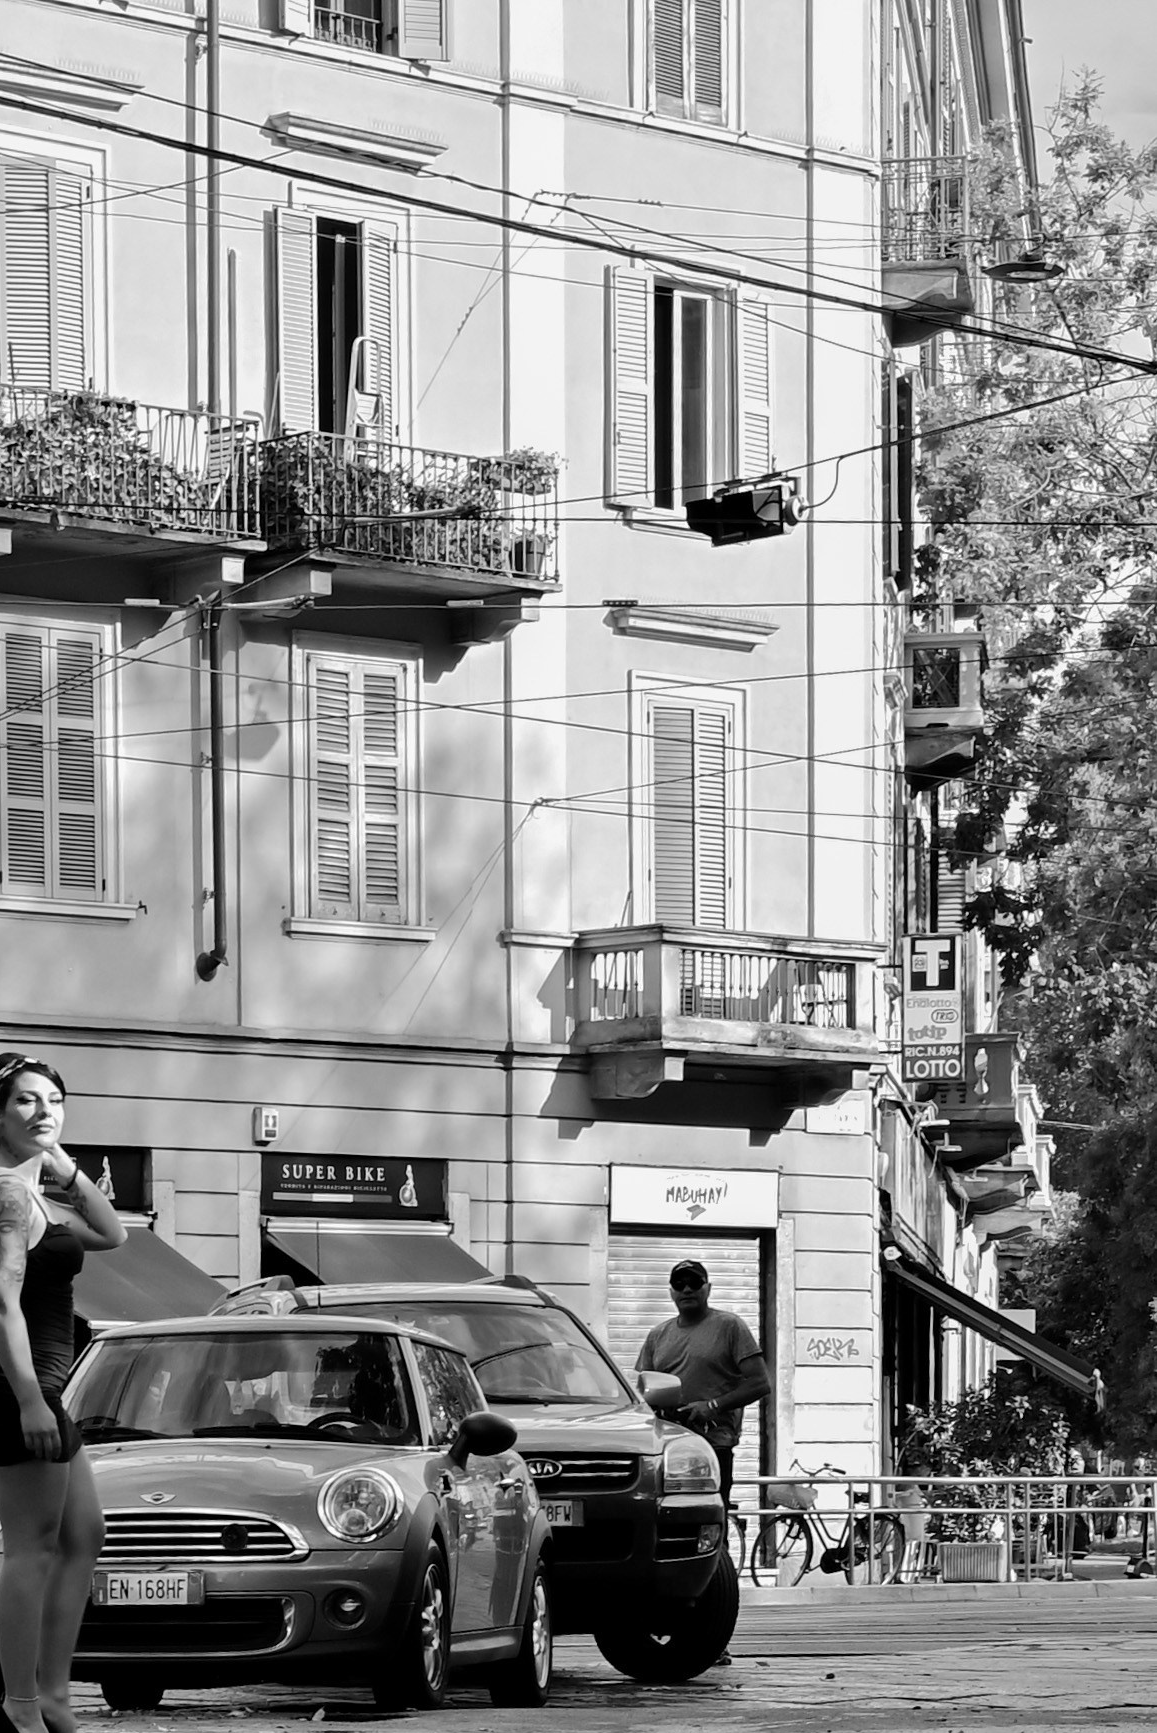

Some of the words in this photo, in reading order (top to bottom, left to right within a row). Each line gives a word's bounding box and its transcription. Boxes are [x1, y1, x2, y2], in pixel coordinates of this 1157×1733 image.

[906, 1059, 961, 1078] LOTTO
[282, 1164, 337, 1180] SUPER
[345, 1166, 386, 1182] BIKE
